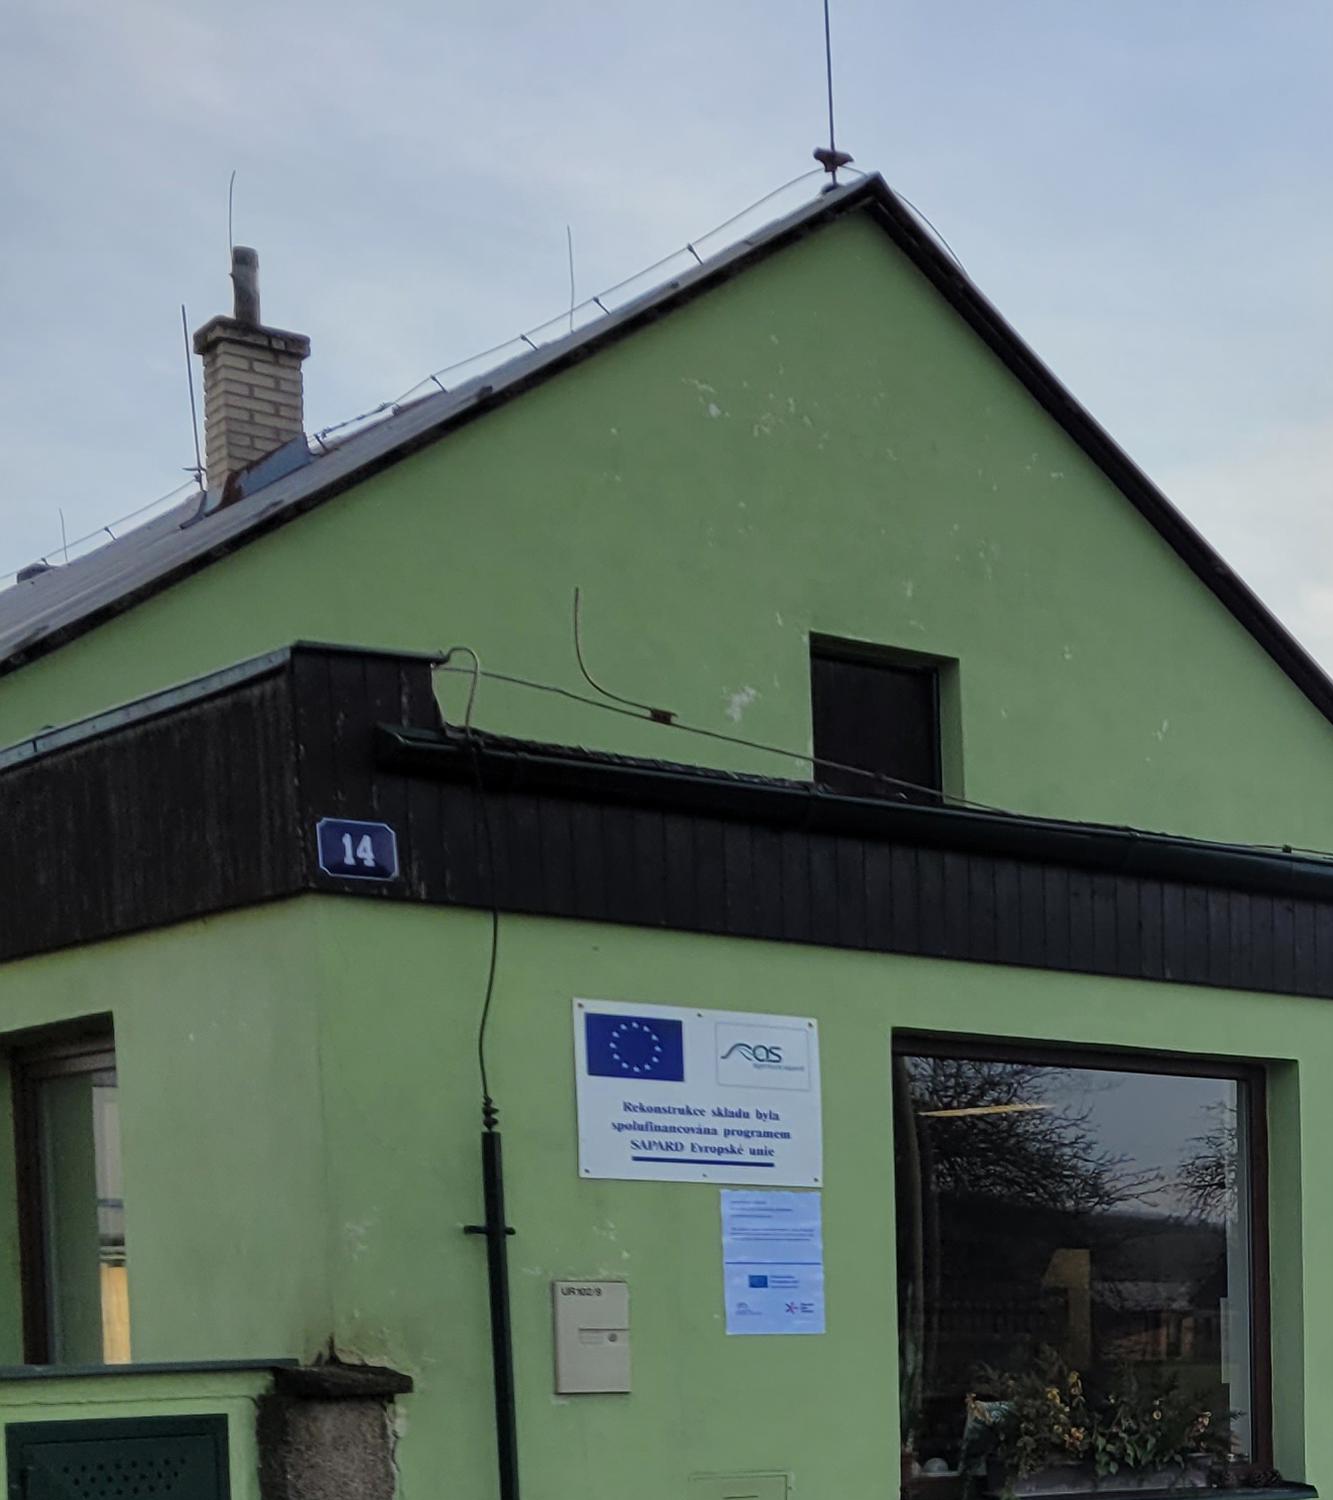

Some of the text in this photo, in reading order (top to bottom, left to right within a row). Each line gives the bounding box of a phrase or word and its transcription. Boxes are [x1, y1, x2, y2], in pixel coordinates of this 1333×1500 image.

[342, 832, 376, 867] 14
[623, 1101, 780, 1122] Rekonstrukce skladu byla
[611, 1120, 791, 1140] spolufinancována programem
[630, 1140, 775, 1157] SAPARD Evropské unie
